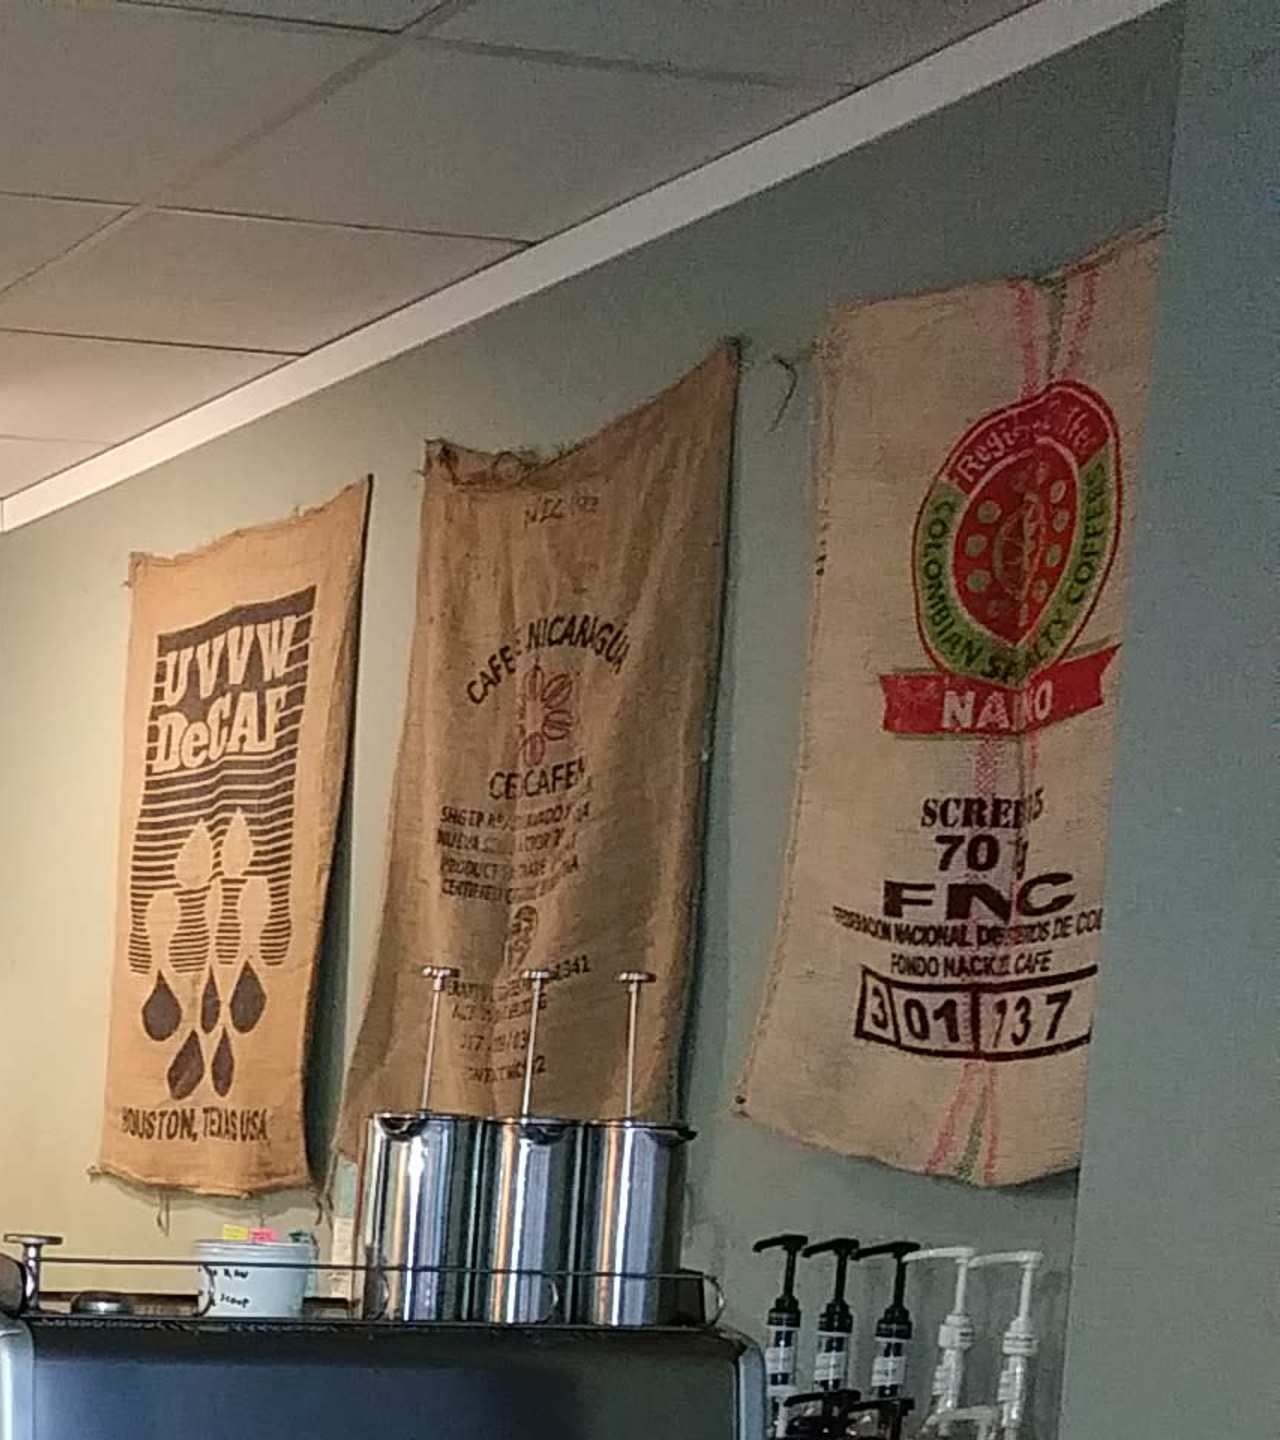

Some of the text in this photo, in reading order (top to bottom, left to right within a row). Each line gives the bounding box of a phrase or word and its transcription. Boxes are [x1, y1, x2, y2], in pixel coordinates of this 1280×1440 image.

[467, 645, 517, 705] CAFE
[935, 834, 1000, 871] 70
[883, 872, 1077, 922] FNC
[1014, 950, 1052, 975] CAFE
[241, 1109, 267, 1142] USA
